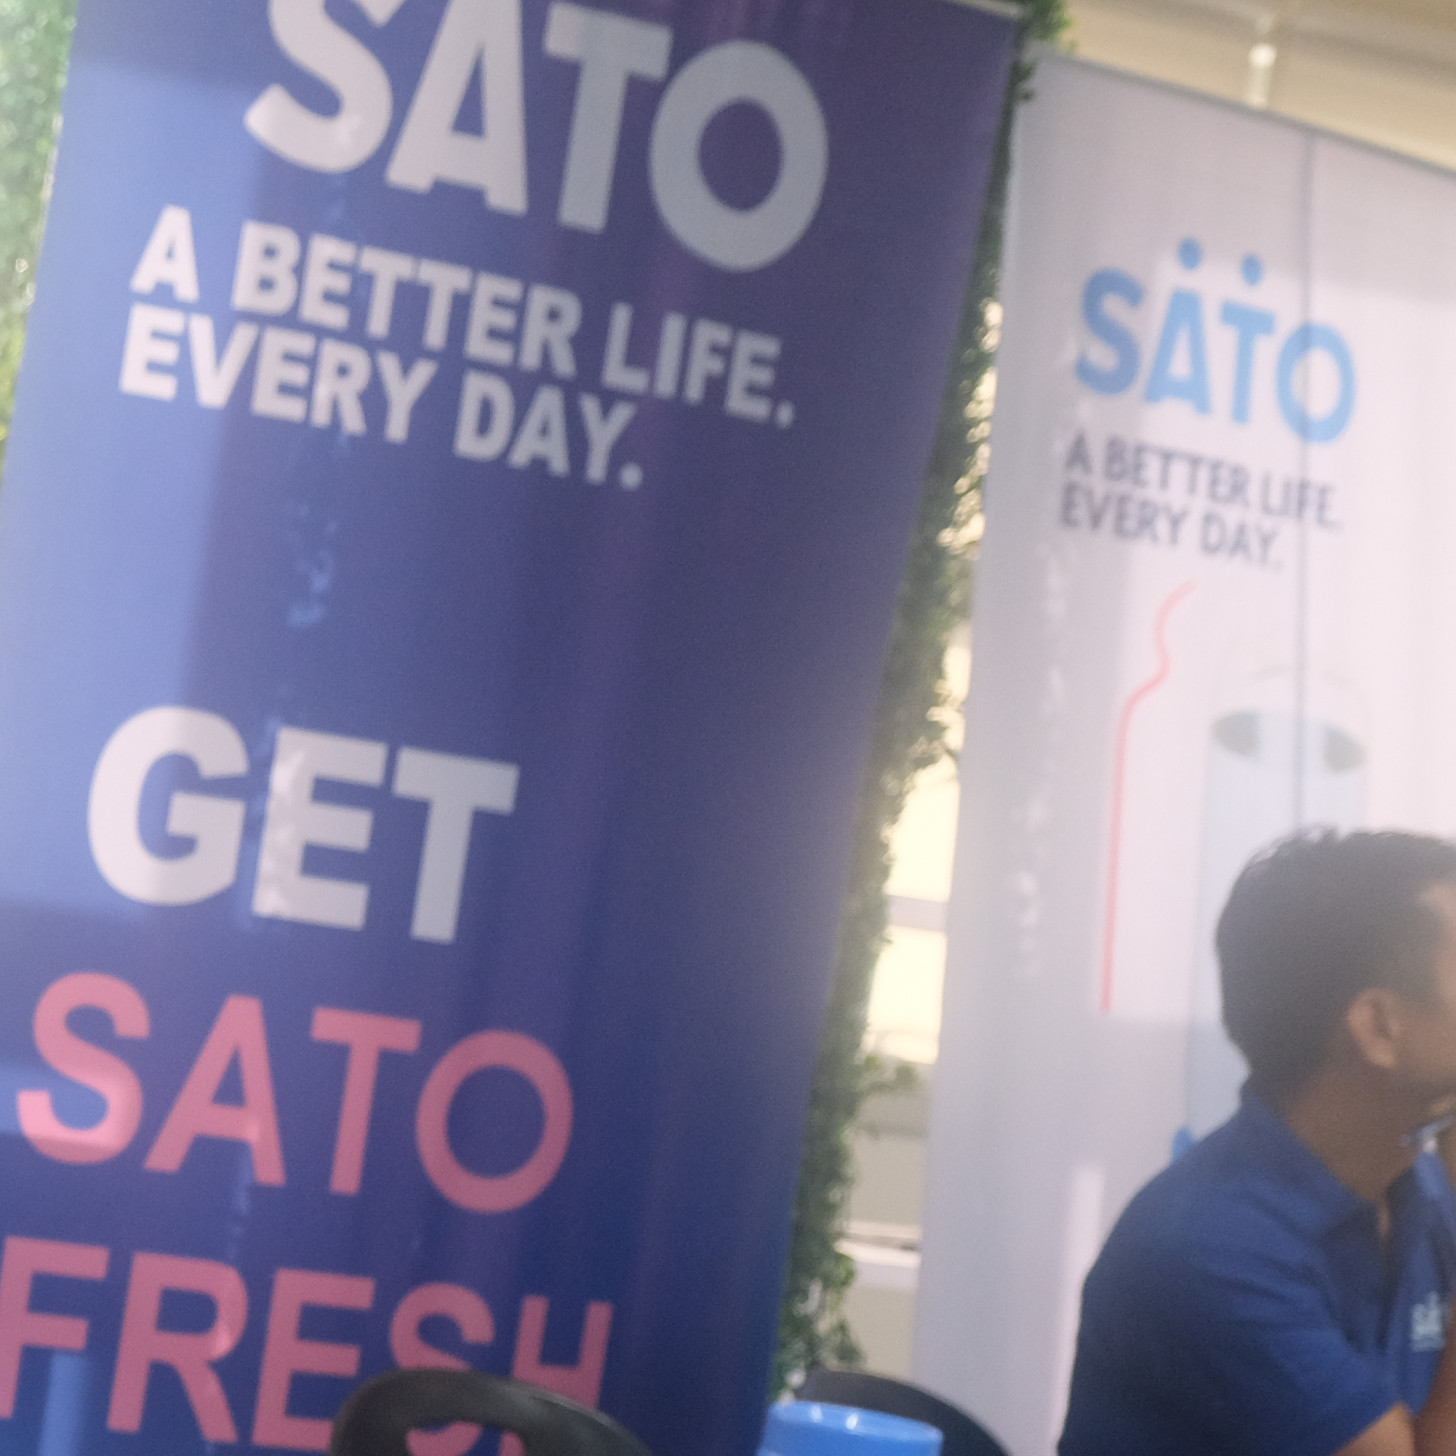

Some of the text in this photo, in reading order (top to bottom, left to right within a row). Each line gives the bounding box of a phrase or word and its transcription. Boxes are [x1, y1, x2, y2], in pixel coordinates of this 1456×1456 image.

[243, 0, 830, 272] SATO
[119, 304, 643, 491] EVERY DAY.
[128, 204, 797, 427] A BETTER LIFE.
[1059, 480, 1189, 547] EVERY
[1064, 433, 1092, 475] A
[1105, 435, 1250, 508] BETTER
[88, 705, 520, 945] GET
[15, 971, 574, 1212] SATO
